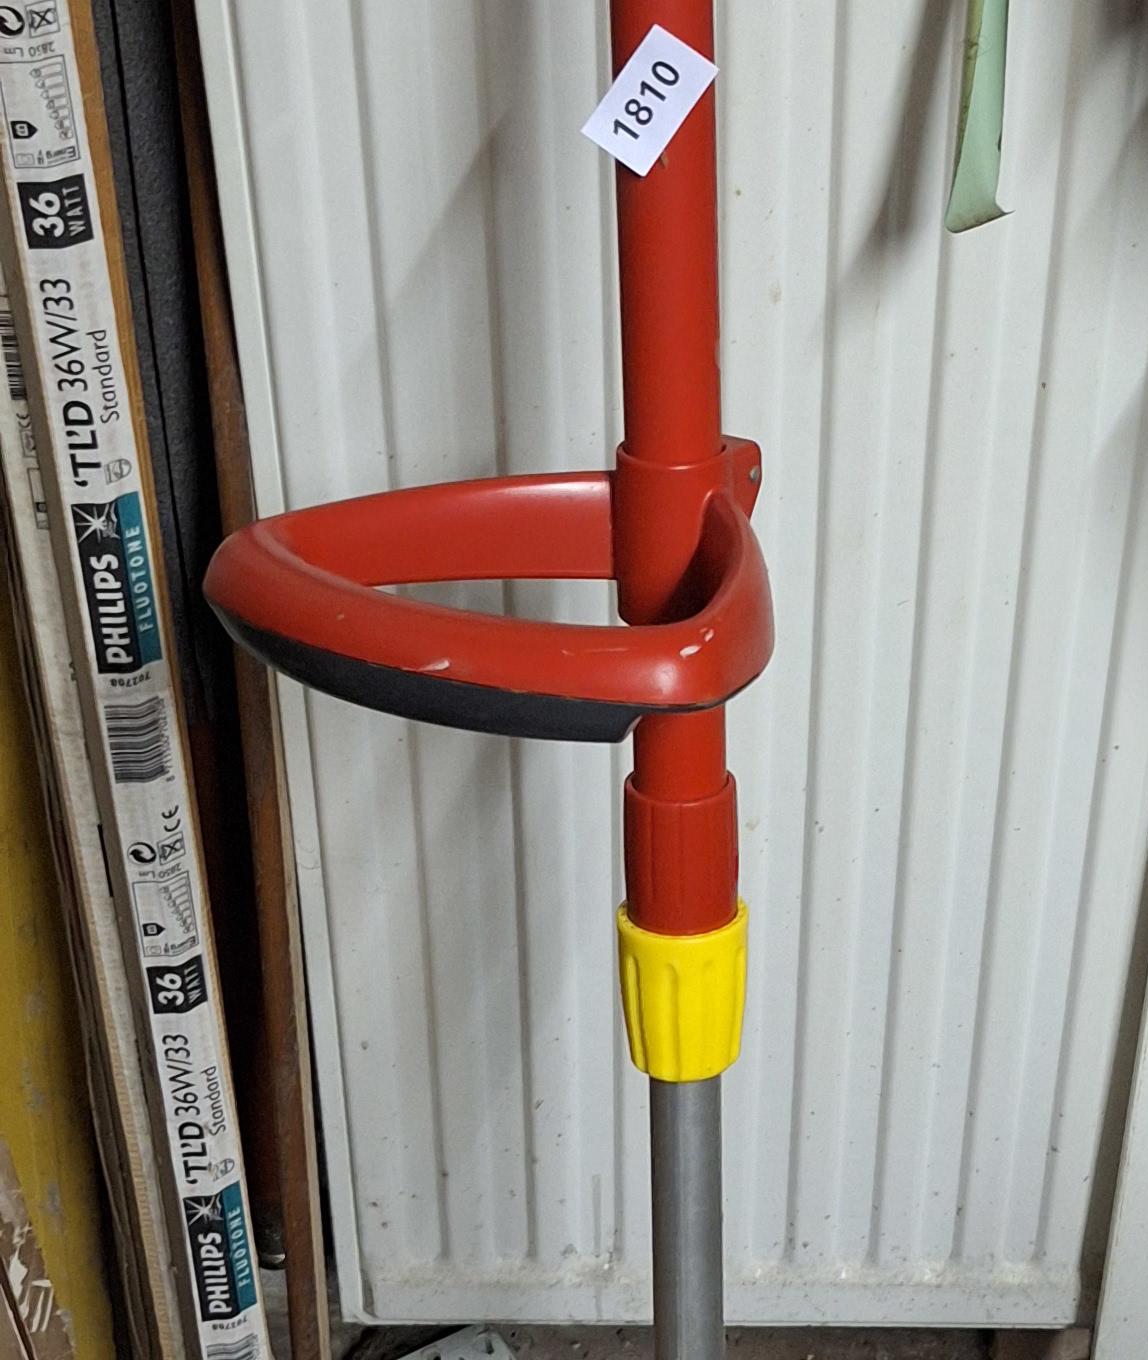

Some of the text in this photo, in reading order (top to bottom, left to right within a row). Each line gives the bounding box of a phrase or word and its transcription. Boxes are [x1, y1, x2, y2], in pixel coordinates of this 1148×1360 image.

[612, 60, 680, 140] 1810
[28, 191, 65, 238] 36
[62, 184, 87, 237] WATT
[39, 278, 88, 392] 36W/33
[86, 328, 120, 424] Standard
[89, 553, 134, 665] PHILIPS
[125, 524, 155, 633] FLUOTONE
[155, 972, 185, 1007] 36
[162, 1034, 201, 1116] 36W/33
[200, 1065, 227, 1136] Standard
[197, 1231, 233, 1314] PHILIPS
[227, 1205, 251, 1288] FLUOTONE
